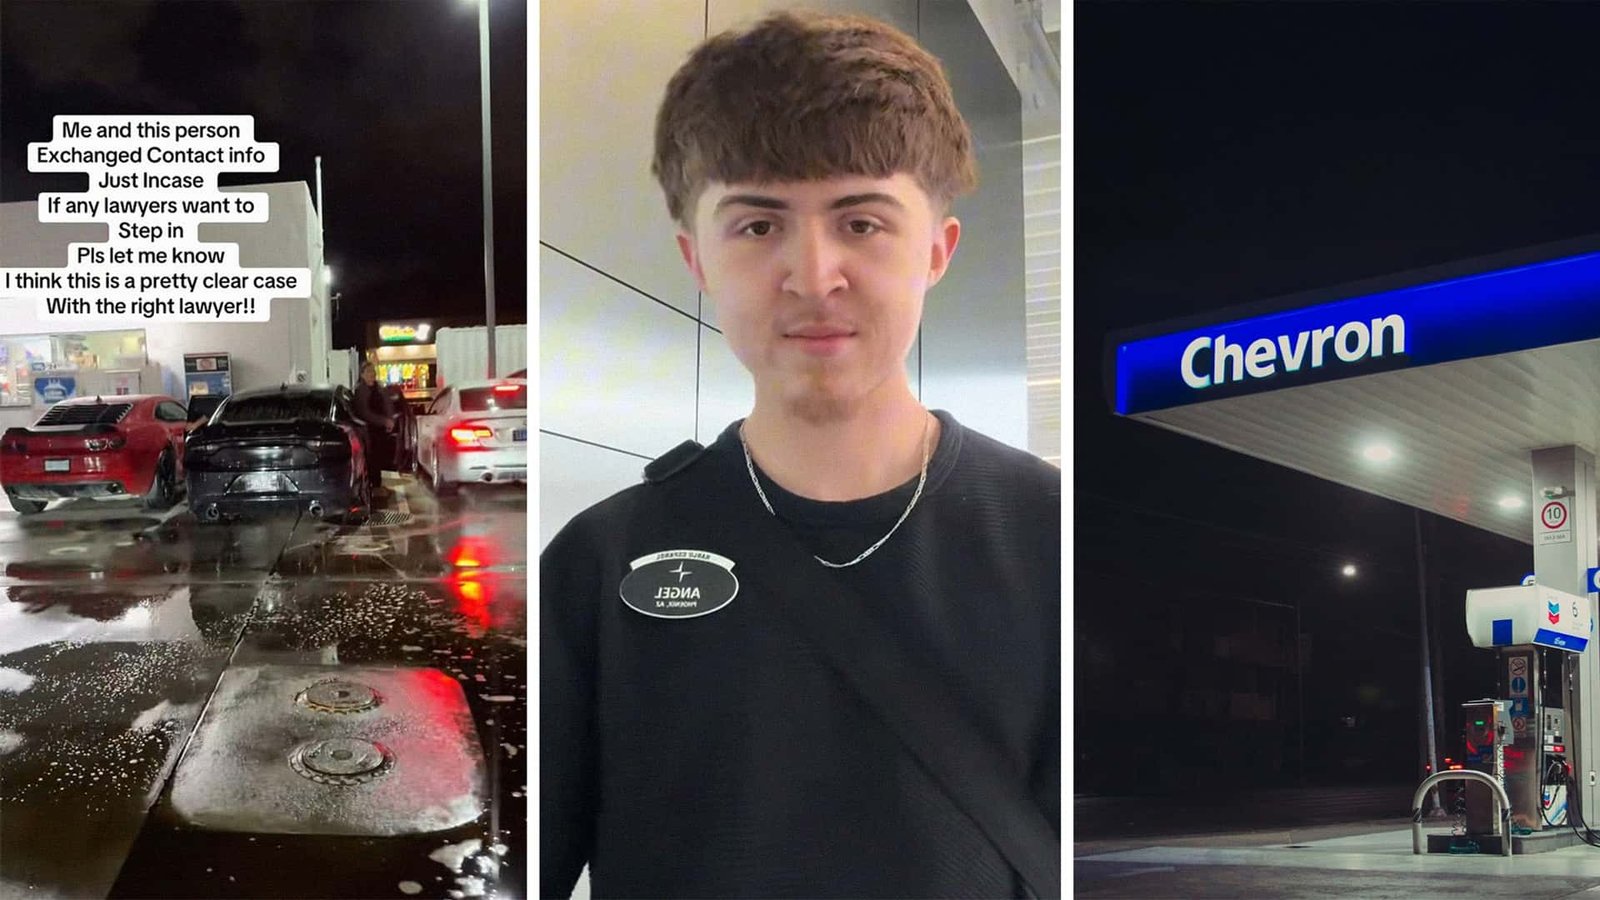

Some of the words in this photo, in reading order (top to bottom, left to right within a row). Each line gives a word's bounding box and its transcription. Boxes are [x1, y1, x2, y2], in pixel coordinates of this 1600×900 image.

[1181, 313, 1405, 389] Chevron
[1547, 507, 1561, 520] 10
[1572, 602, 1579, 617] 6
